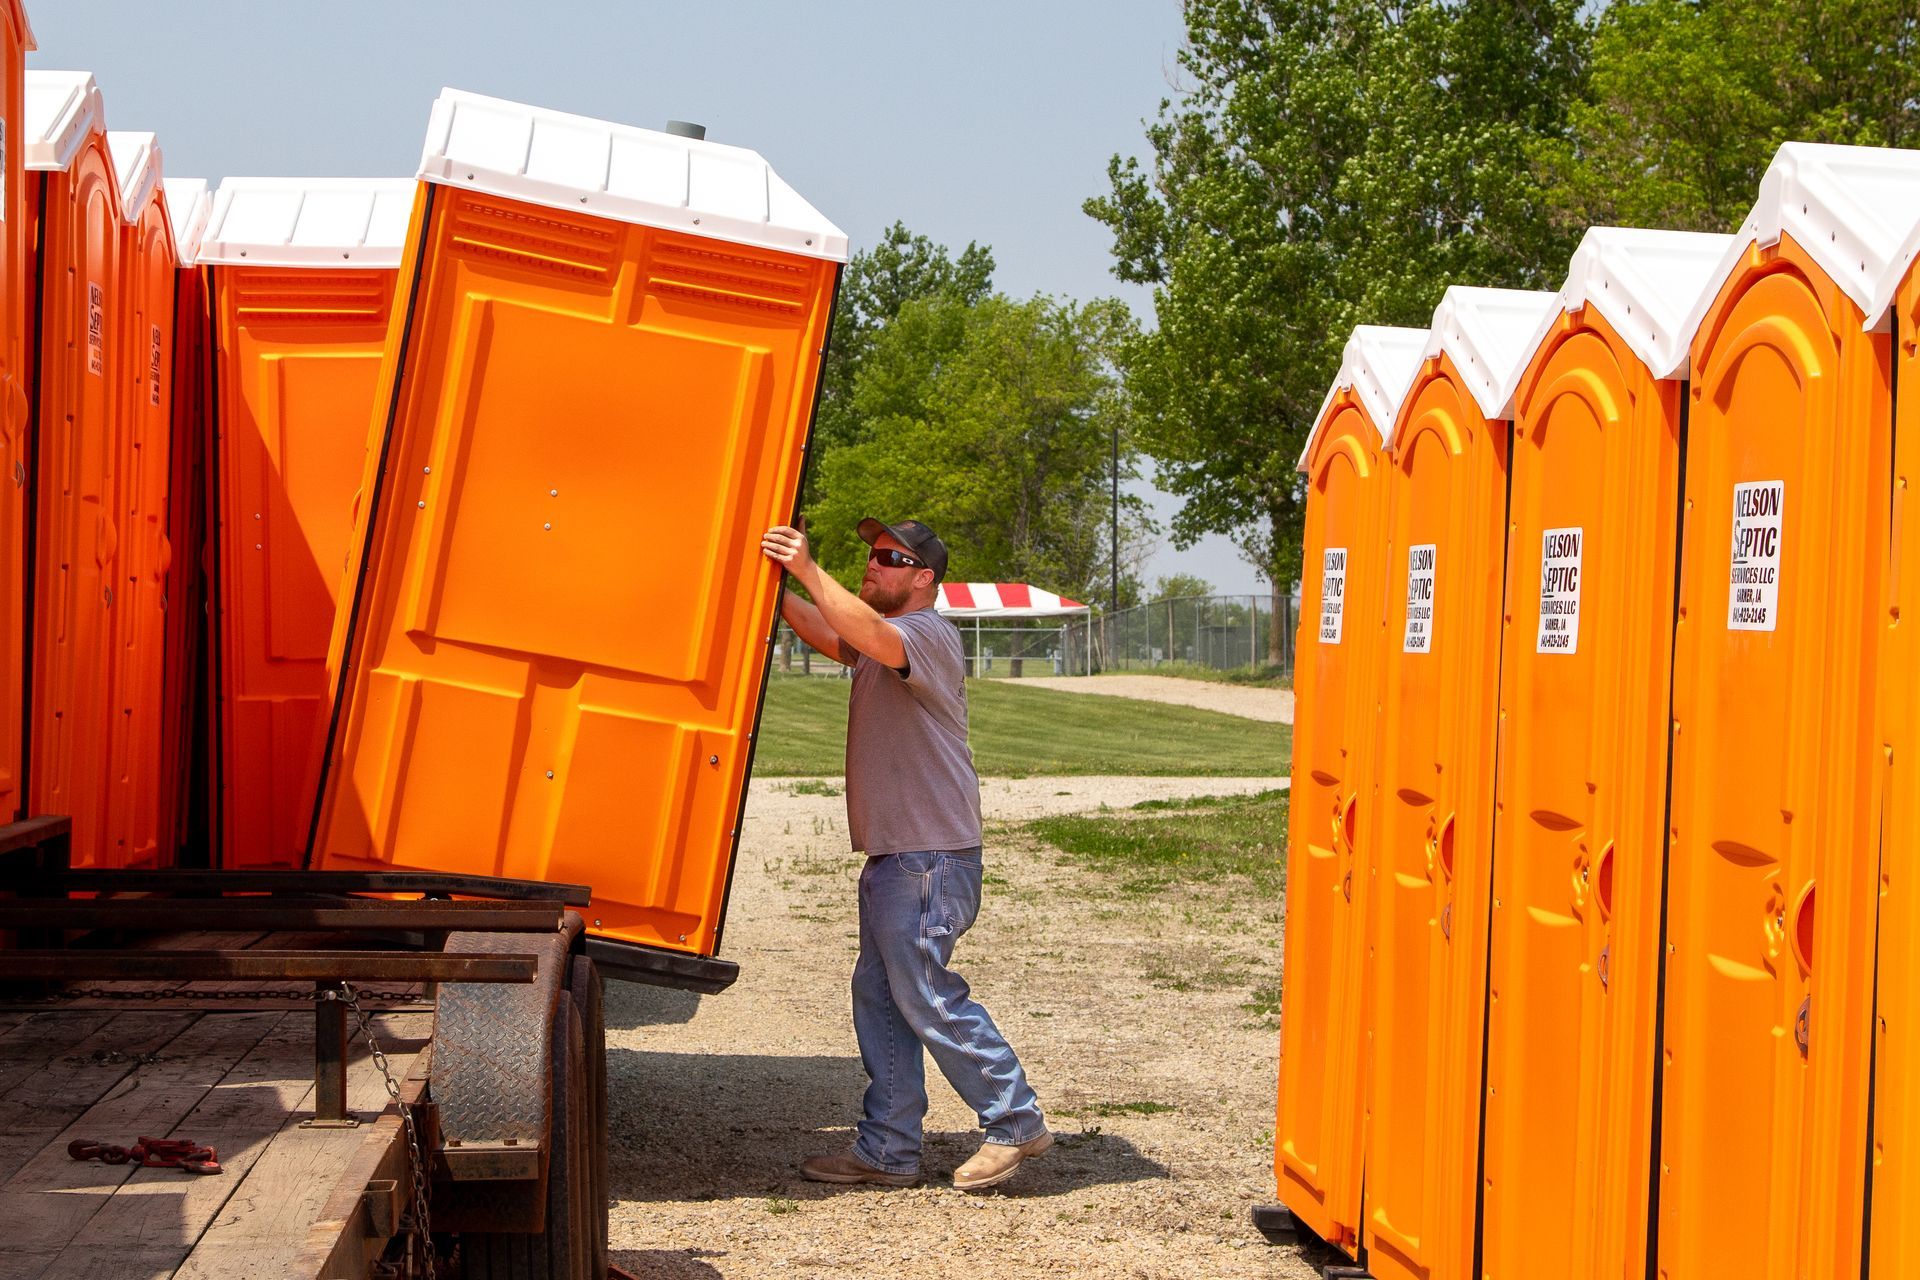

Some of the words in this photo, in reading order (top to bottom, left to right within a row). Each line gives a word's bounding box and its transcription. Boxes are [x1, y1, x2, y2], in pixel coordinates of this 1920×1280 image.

[1735, 488, 1781, 518] NELSON
[1544, 533, 1580, 559] NELSON
[1733, 519, 1778, 560] SEPTIC
[1324, 552, 1346, 571] NELSON
[1410, 549, 1435, 571] NELSON
[1408, 572, 1432, 601] SEPTIC
[1542, 560, 1578, 594] SEPTIC
[1731, 567, 1759, 584] SERVICES
[1759, 567, 1774, 584] LLC
[1541, 600, 1563, 614] SERVICES
[1563, 600, 1576, 614] LLC
